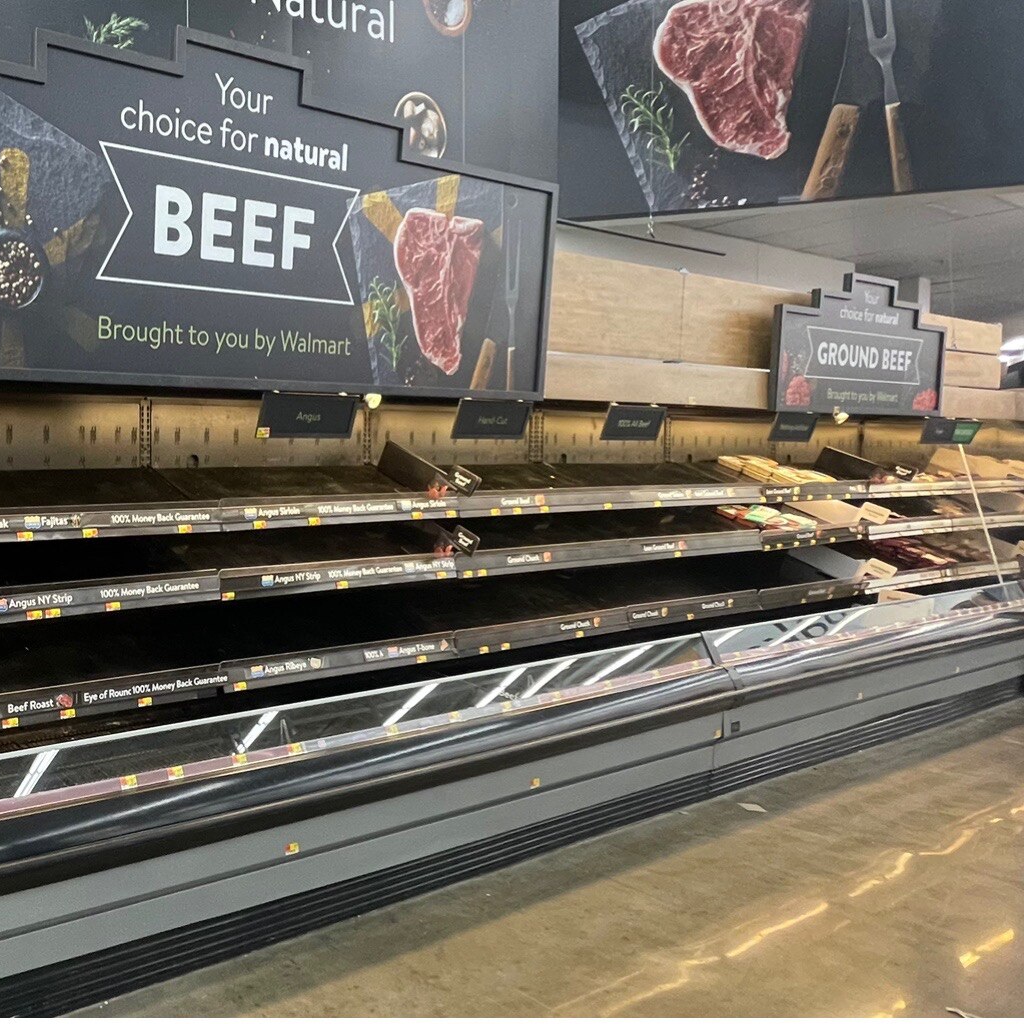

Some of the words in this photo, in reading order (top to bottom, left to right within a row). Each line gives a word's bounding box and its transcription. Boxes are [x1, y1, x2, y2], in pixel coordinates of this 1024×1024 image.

[251, 0, 394, 43] atural
[215, 73, 273, 115] Your
[120, 99, 212, 145] choice
[220, 118, 257, 152] for
[264, 135, 348, 171] natural
[154, 184, 315, 270] BEEF
[864, 290, 879, 304] Your
[840, 305, 863, 321] choice
[864, 308, 874, 322] for
[875, 313, 899, 325] natural
[98, 316, 182, 349] Brought
[189, 325, 209, 346] to
[214, 332, 249, 354] you
[254, 328, 276, 356] by
[280, 330, 351, 356] Walmart
[817, 341, 879, 369] GROUND
[881, 350, 912, 372] BEEF
[296, 411, 321, 423] Angus
[111, 514, 130, 524] 100%
[132, 513, 155, 525] Money
[157, 512, 173, 522] Back
[175, 511, 210, 522] Guarantee
[258, 508, 279, 518] Angus
[41, 515, 68, 528] Fajitas
[415, 562, 431, 571] Angus
[274, 574, 294, 584] Angus
[295, 573, 304, 581] NY
[306, 571, 321, 582] Strip
[100, 588, 119, 598] 100%
[121, 586, 143, 598] Money
[146, 584, 163, 594] Back
[164, 582, 199, 593] Guarantee
[9, 597, 36, 608] Angus
[38, 595, 50, 605] NY
[52, 593, 72, 605] Strip
[399, 646, 416, 655] Angus
[265, 664, 284, 675] Angus
[286, 661, 306, 672] Ribeye
[132, 683, 151, 694] 100%
[152, 682, 175, 692] Money
[176, 679, 192, 688] Back
[193, 674, 228, 685] Guarantee
[84, 692, 97, 703] Eye
[99, 690, 108, 699] of
[7, 701, 27, 713] Beef
[30, 698, 53, 710] Roast
